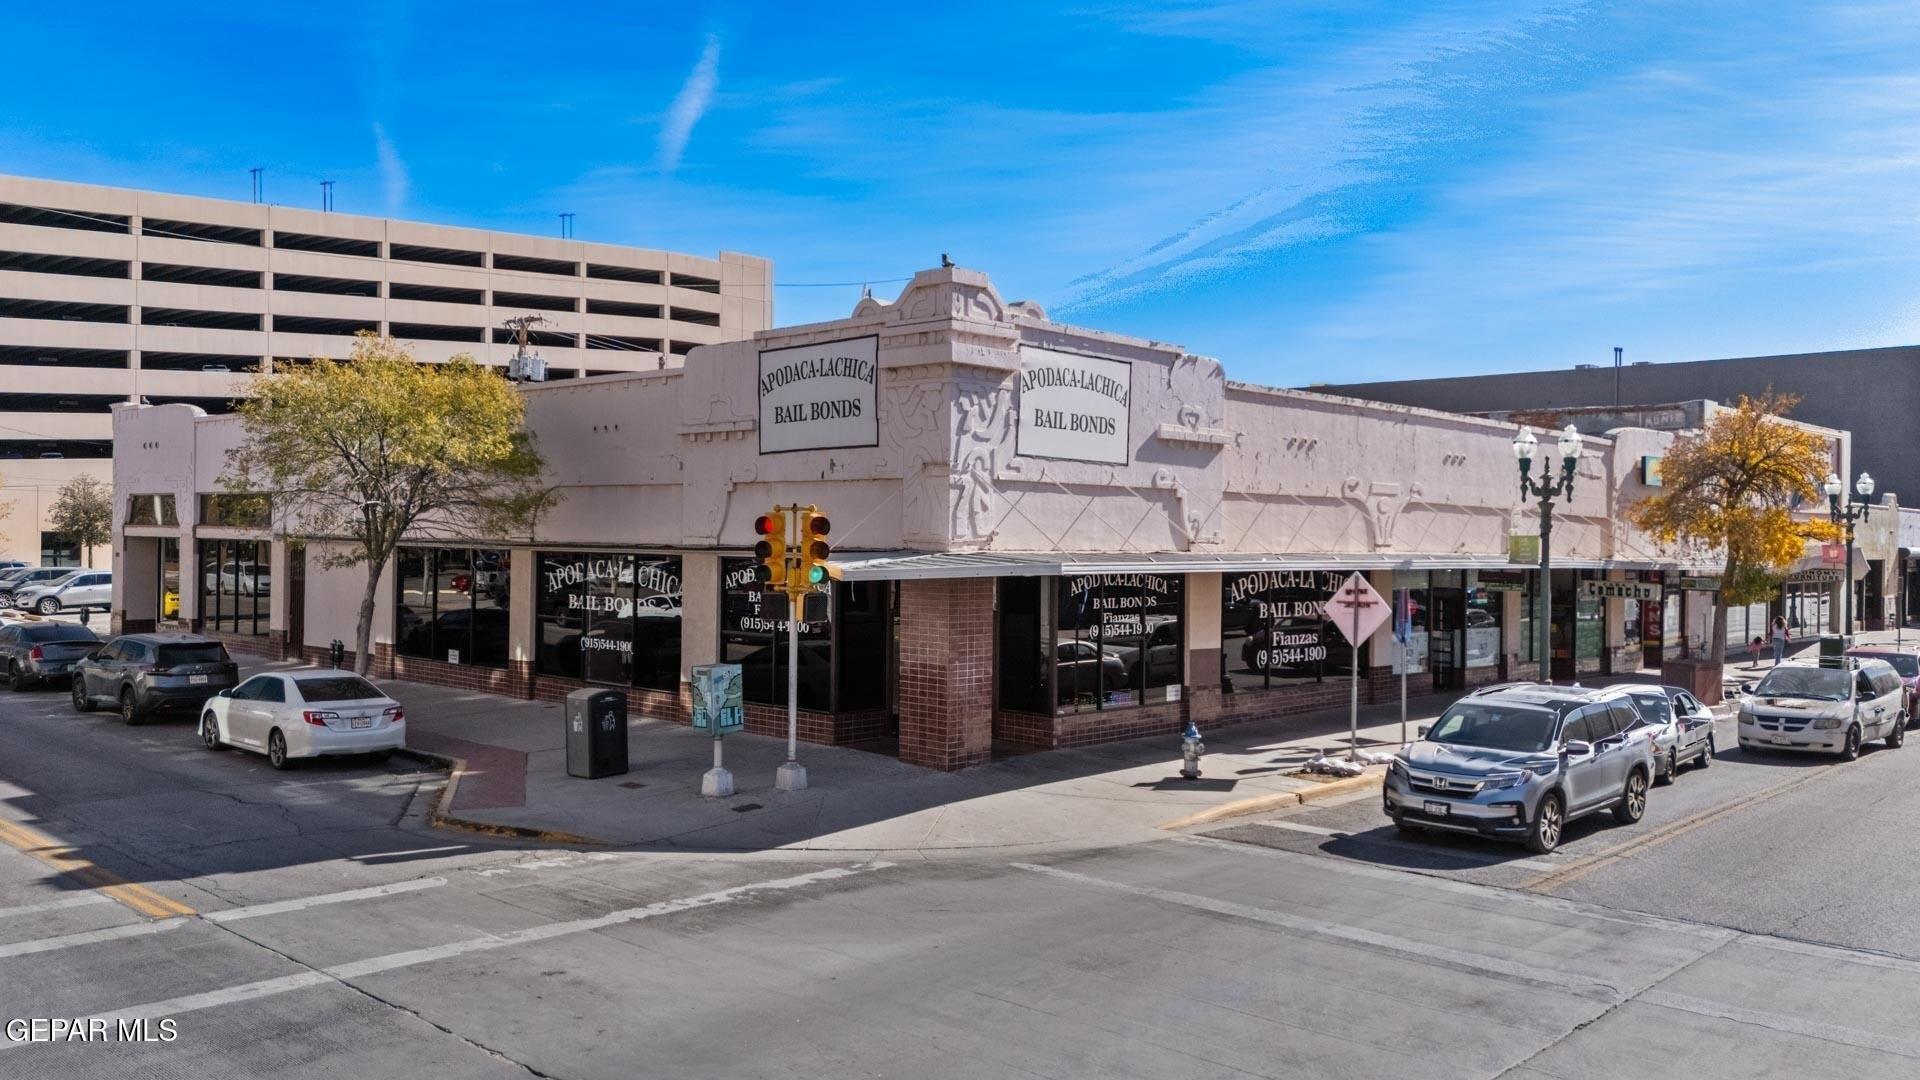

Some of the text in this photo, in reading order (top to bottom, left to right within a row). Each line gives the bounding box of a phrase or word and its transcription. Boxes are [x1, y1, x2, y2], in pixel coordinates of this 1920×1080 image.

[761, 356, 876, 397] APODACA-LACHICA
[1020, 366, 1129, 408] APODACA-LACHICA
[774, 397, 862, 425] BAIL BONDS
[1033, 408, 1116, 436] BAIL BONDS
[1070, 573, 1168, 597] APODACA-LACHICA
[568, 594, 602, 611] BAIL
[1093, 595, 1157, 610] BAIL BONDS
[1259, 601, 1291, 619] BAIL
[1103, 612, 1141, 624] Fianzas
[1272, 631, 1319, 647] Fianzas
[1256, 646, 1327, 668] (95)544-1900
